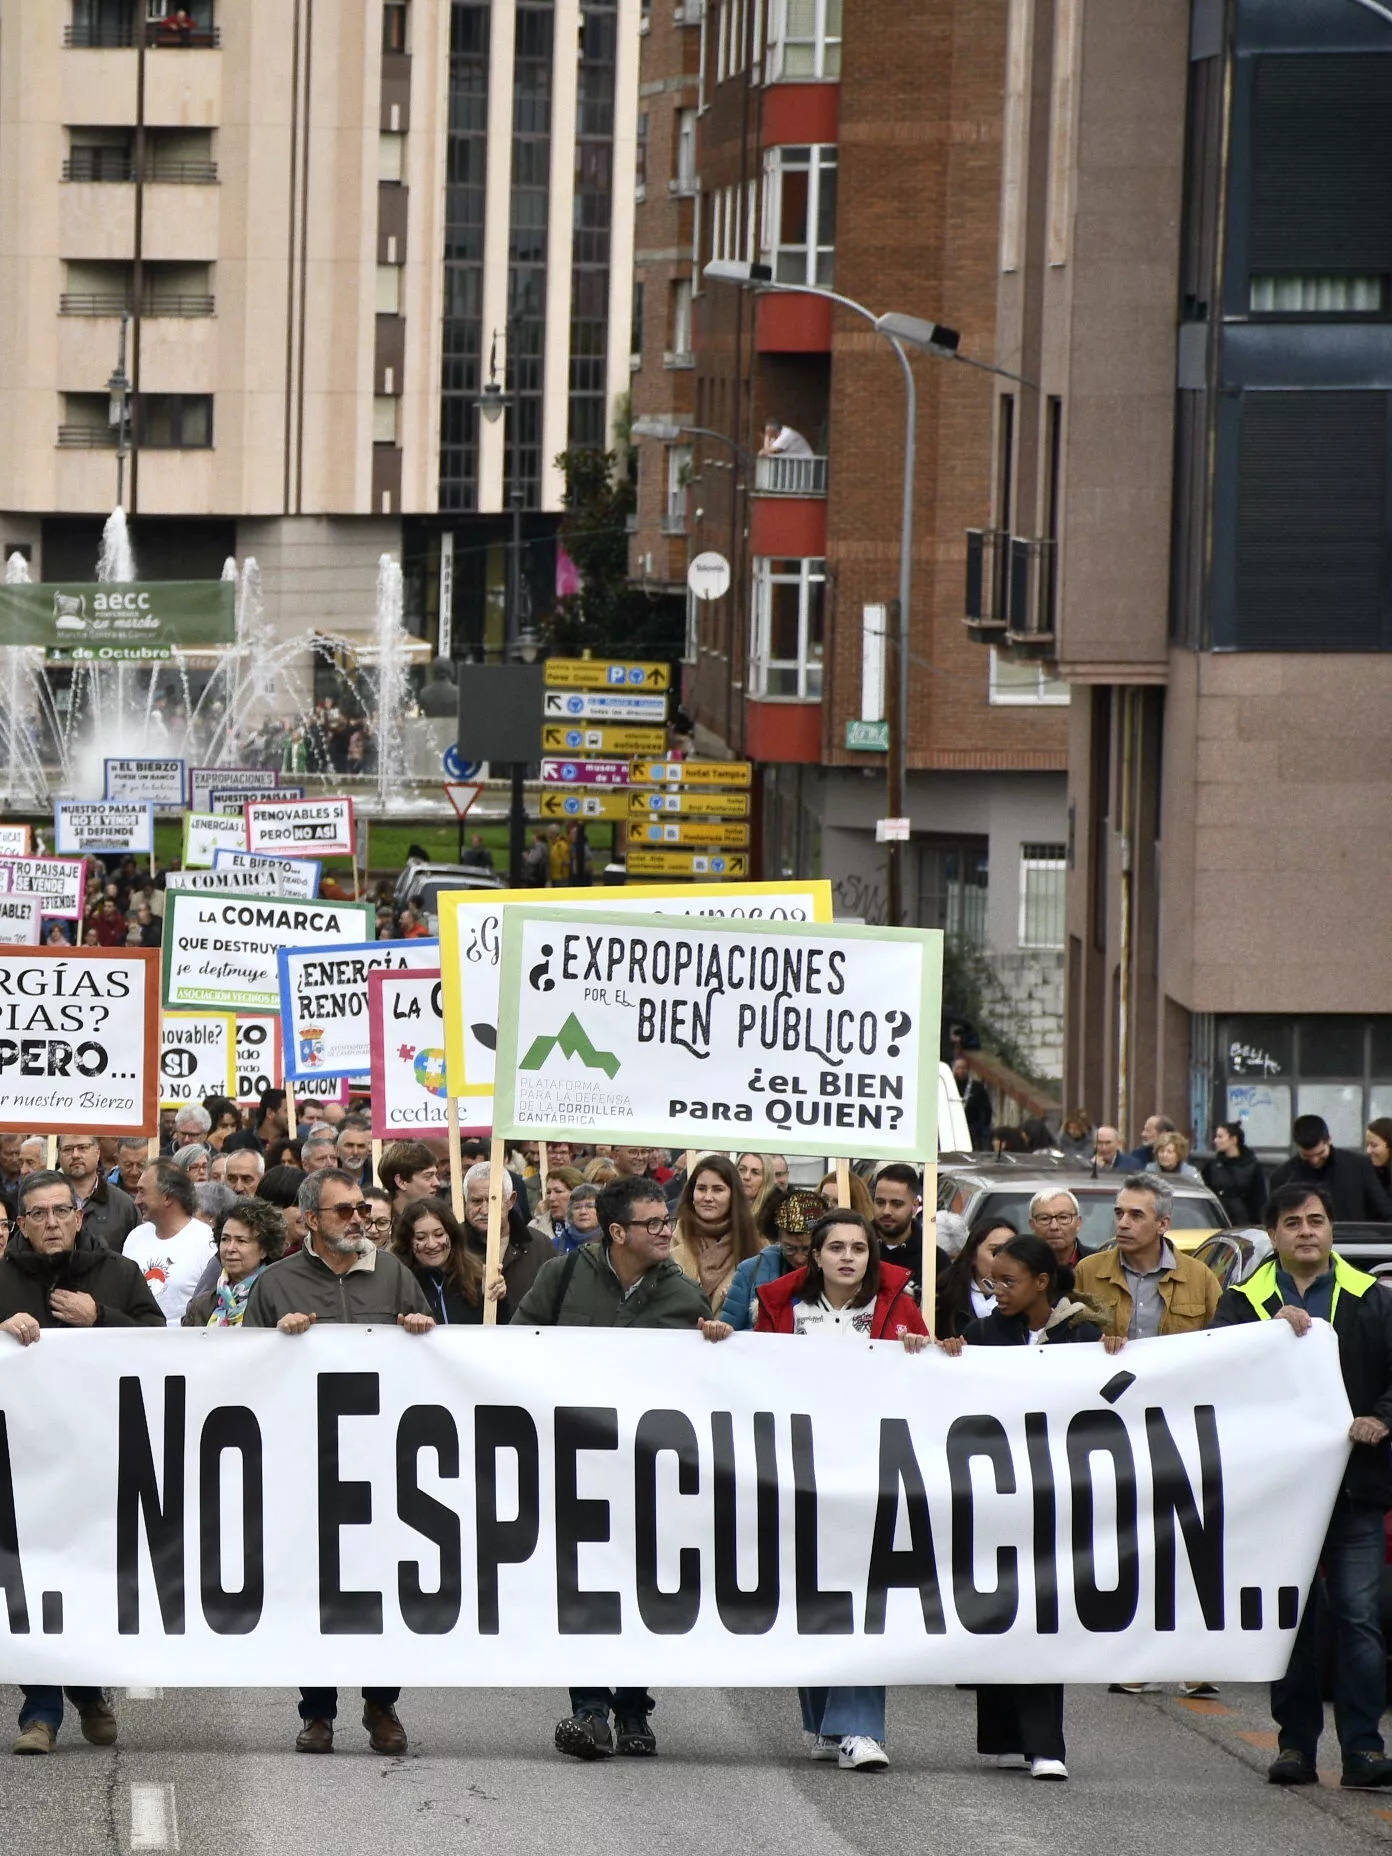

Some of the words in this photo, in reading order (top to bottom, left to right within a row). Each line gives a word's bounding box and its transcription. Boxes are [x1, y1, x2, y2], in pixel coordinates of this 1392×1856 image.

[93, 592, 150, 610] aecc
[71, 646, 93, 659] de
[99, 646, 171, 659] Octubre
[119, 762, 130, 772] EL
[135, 762, 179, 772] BIERZO
[214, 793, 257, 804] NUESTRO
[61, 805, 106, 814] NUESTRO
[108, 804, 147, 814] PAISAJE
[253, 806, 330, 822] RENOVABLES
[333, 804, 344, 818] SÍ
[88, 827, 134, 837] DEFIENDE
[260, 827, 292, 841] PERO
[294, 826, 313, 840] NO
[233, 855, 245, 866] EL
[35, 863, 79, 879] PAISAJE
[32, 878, 64, 893] VENDE
[192, 872, 276, 888] COMARCA
[41, 896, 76, 909] EFIENDE
[199, 911, 217, 923] LA
[222, 906, 342, 933] COMARCA
[178, 936, 209, 952] QUE
[466, 916, 500, 966] ¿G
[199, 959, 269, 983] destruye
[528, 934, 846, 1000] ¿EXPROPIACIONES
[393, 992, 422, 1020] LA
[637, 987, 726, 1060] BIEN
[164, 1052, 189, 1076] SI
[170, 1083, 192, 1098] NO
[520, 1077, 601, 1092] PLATAFORMA
[819, 1070, 904, 1100] BIEN
[12, 1091, 74, 1109] nuestro
[79, 1091, 134, 1111] Bierzo
[520, 1089, 552, 1101] PARA
[556, 1091, 574, 1102] LA
[575, 1092, 631, 1106] DEFENSA
[519, 1100, 537, 1111] DE
[539, 1101, 554, 1112] LA
[558, 1102, 634, 1117] CORDILLERA
[765, 1100, 904, 1132] QUIEN?
[518, 1111, 596, 1126] CANTÁBRICA
